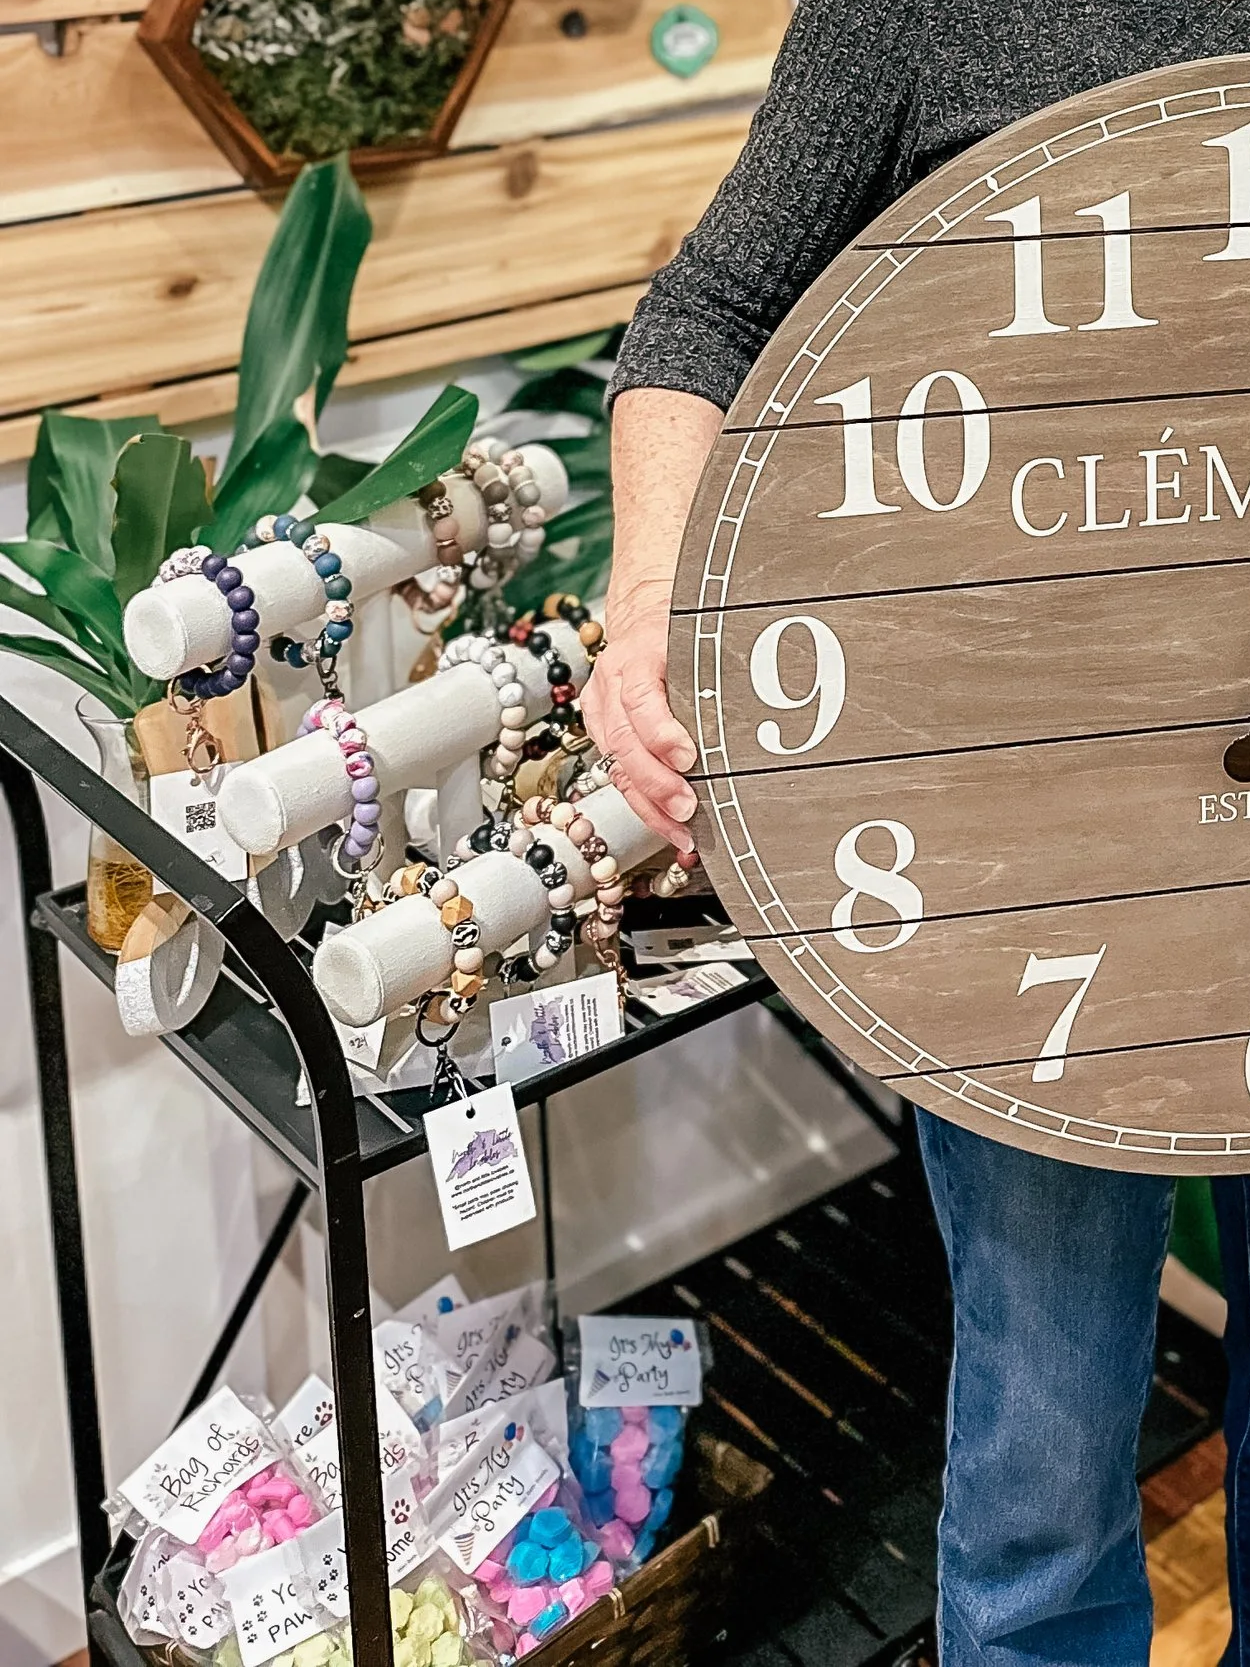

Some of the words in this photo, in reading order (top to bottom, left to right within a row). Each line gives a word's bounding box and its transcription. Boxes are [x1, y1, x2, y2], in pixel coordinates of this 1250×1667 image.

[985, 190, 1160, 337] 11
[814, 370, 991, 519] 10
[750, 615, 847, 755] 9
[831, 819, 924, 954] 8
[1017, 943, 1107, 1083] 7
[618, 1361, 668, 1393] Party
[641, 1331, 672, 1359] My
[160, 1456, 210, 1498] Bag
[207, 1423, 230, 1451] of
[453, 1476, 480, 1517] It's
[479, 1446, 511, 1485] My
[471, 1475, 524, 1532] Party
